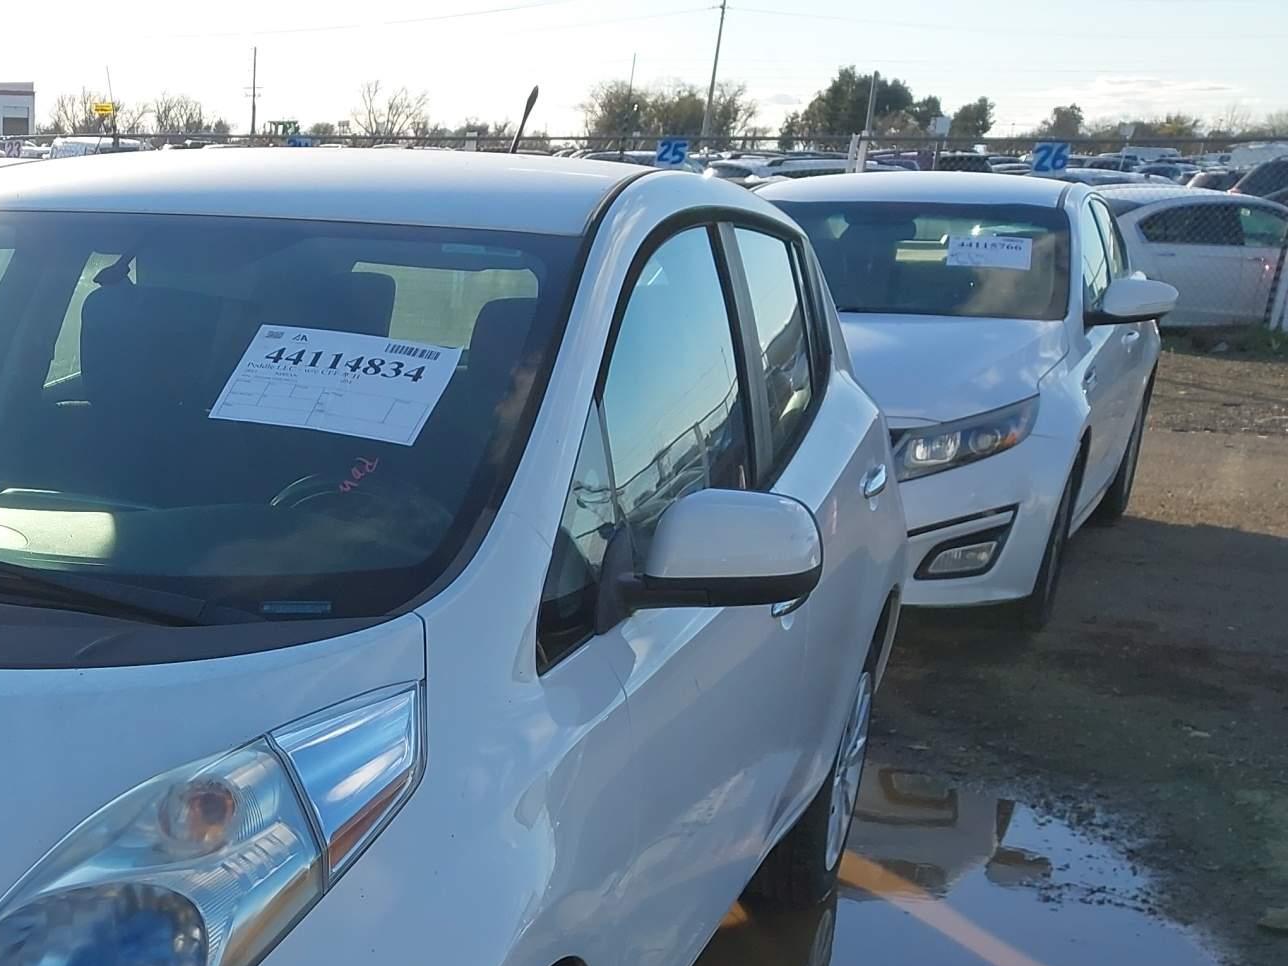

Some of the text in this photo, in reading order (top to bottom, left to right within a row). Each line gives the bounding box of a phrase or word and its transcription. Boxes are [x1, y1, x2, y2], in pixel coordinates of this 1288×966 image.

[657, 140, 688, 165] 25
[1033, 144, 1068, 172] 26
[265, 347, 426, 383] 44114834
